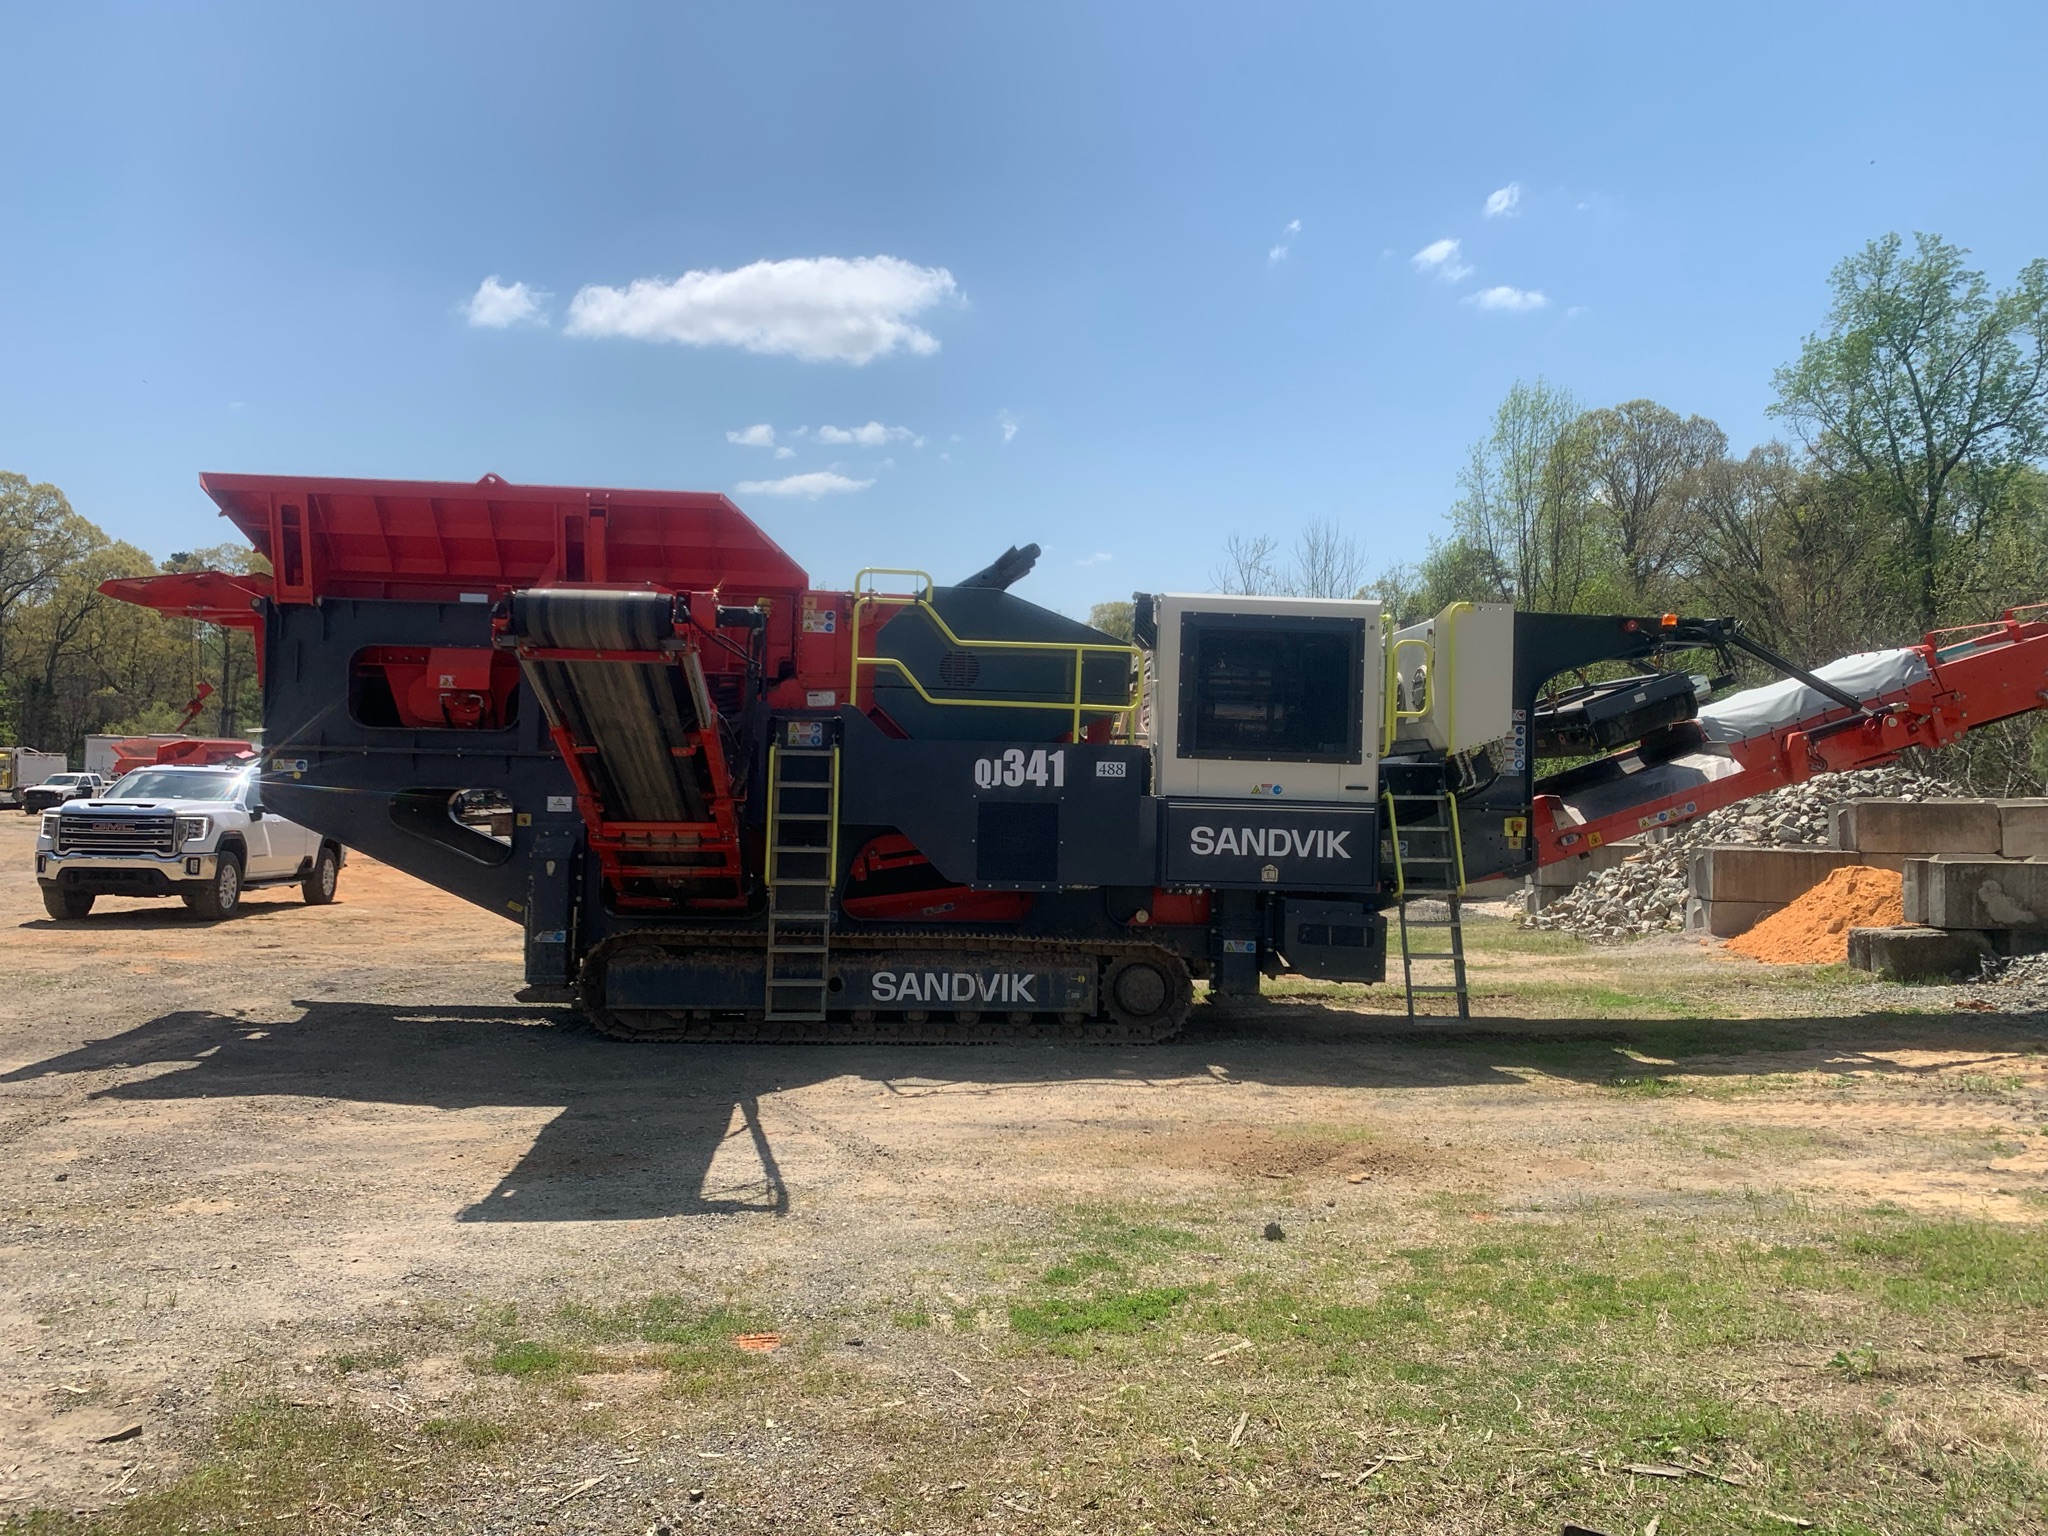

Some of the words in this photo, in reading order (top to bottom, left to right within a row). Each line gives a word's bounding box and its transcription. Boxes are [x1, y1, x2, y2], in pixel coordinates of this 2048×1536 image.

[974, 748, 1065, 789] QJ341
[1098, 763, 1124, 776] 488
[92, 822, 136, 831] GMC
[1190, 826, 1352, 859] SANDVIK
[871, 971, 1036, 1003] SANDVIK
